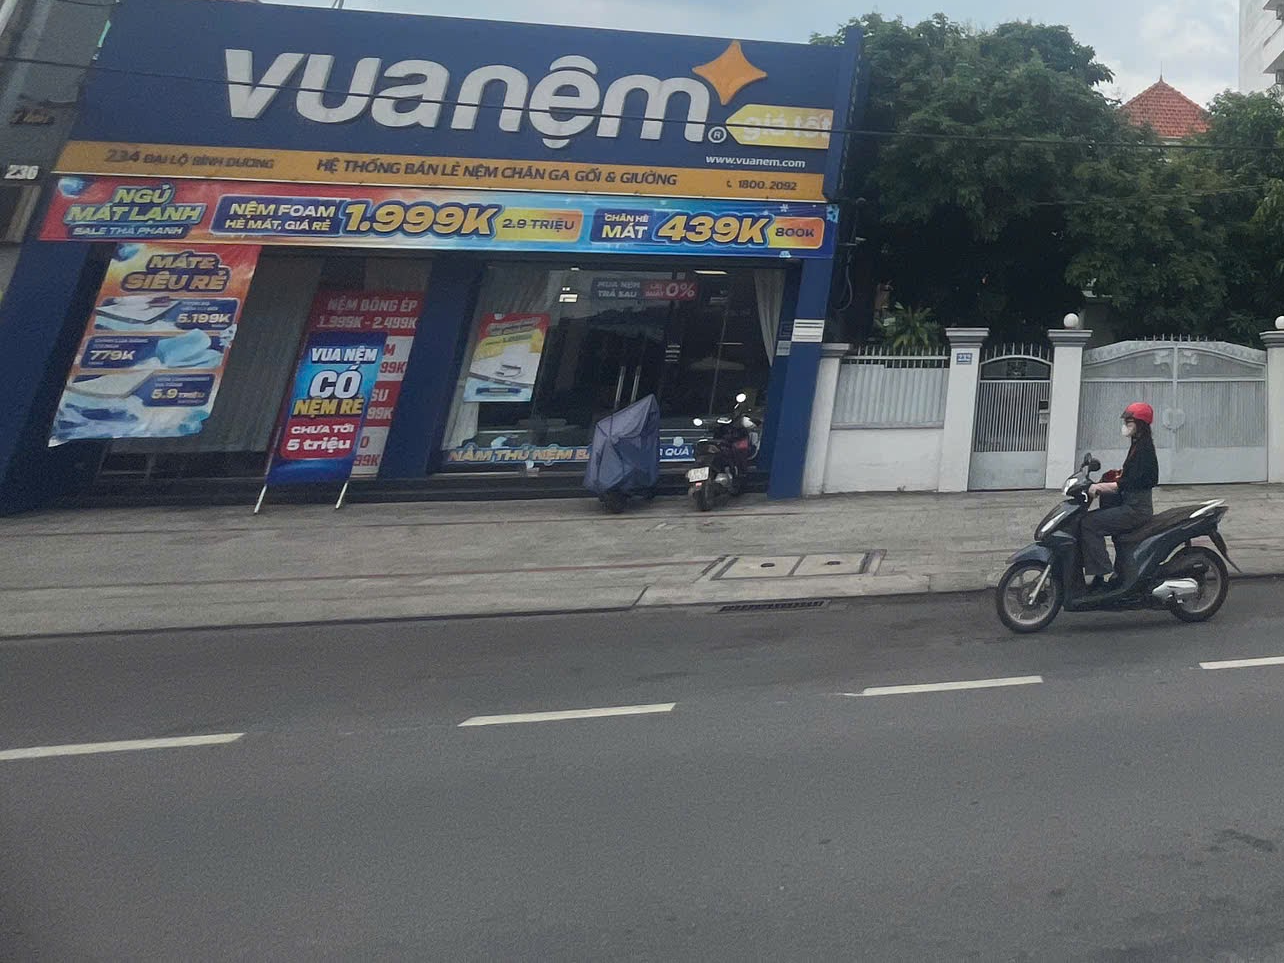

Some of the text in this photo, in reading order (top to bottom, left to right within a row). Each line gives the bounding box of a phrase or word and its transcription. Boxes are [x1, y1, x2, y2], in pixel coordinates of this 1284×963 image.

[104, 149, 140, 163] 234
[705, 155, 806, 169] www.vuanem.com
[4, 164, 39, 179] 236
[317, 158, 338, 174] HỆ
[344, 158, 400, 174] THỐNG
[404, 160, 441, 176] BÁN
[463, 163, 498, 179] NỆM
[548, 169, 569, 181] GA
[575, 168, 600, 182] GỐI
[605, 171, 617, 182] &
[620, 170, 677, 186] GIƯỜNG
[68, 202, 202, 224] MÁT LẠNH
[229, 201, 335, 218] NỆM FOAM
[225, 218, 247, 230] HÈ
[284, 219, 311, 231] GIÁ
[345, 204, 498, 235] 1.999K
[502, 217, 574, 233] 2.9 TRIỆU
[73, 226, 107, 235] SALE
[137, 226, 183, 236] PHANH
[601, 222, 648, 239] MÁT
[657, 215, 771, 244] 439K
[775, 227, 814, 238] 800K
[124, 271, 188, 289] SIÊU
[666, 282, 695, 297] 0%
[90, 350, 136, 361] 779K
[311, 348, 341, 362] VUA
[343, 346, 378, 365] NỆM
[309, 365, 362, 399] CÓ
[293, 396, 338, 418] NỆM
[291, 425, 332, 434] CHƯA
[287, 439, 301, 451] 5
[302, 437, 351, 453] triệu
